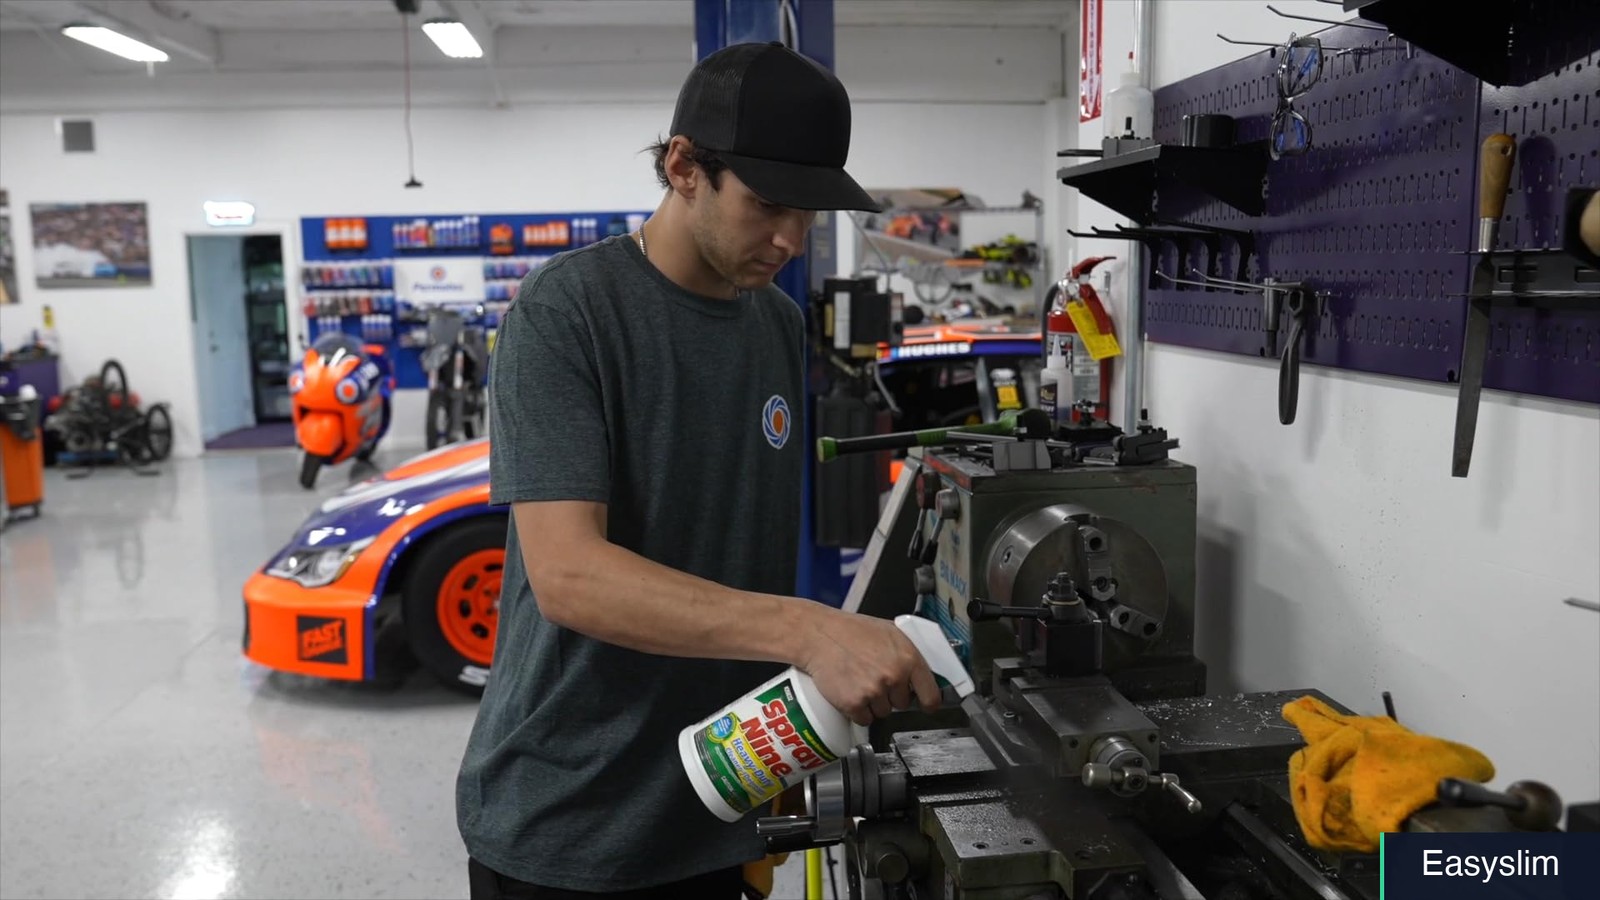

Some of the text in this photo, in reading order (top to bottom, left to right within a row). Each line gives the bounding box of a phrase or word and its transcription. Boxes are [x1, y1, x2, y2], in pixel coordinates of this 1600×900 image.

[898, 343, 969, 357] HUGHES
[740, 716, 792, 778] Nine
[761, 698, 827, 770] Spray
